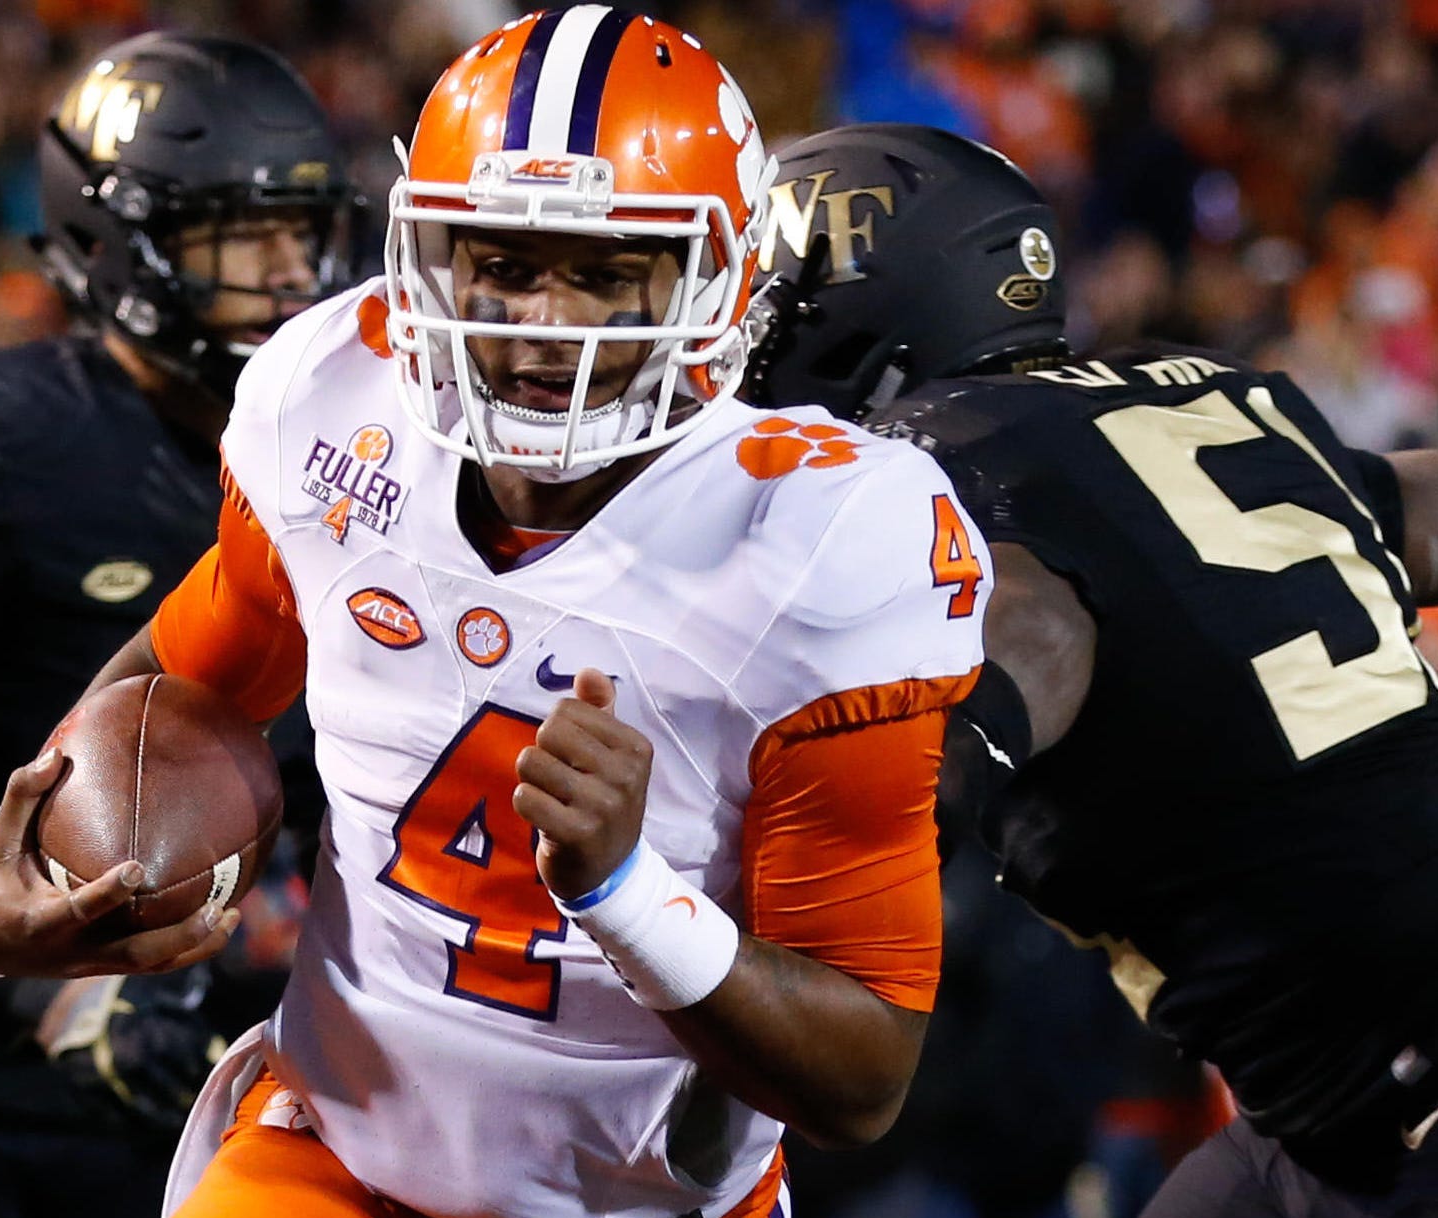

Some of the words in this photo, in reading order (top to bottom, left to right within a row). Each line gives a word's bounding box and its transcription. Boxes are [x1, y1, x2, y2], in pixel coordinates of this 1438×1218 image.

[513, 159, 576, 178] ACC
[757, 169, 894, 285] WF
[304, 438, 401, 518] FULLER
[308, 479, 332, 501] 1975
[321, 495, 353, 546] 4
[357, 506, 380, 528] 1978
[929, 494, 983, 620] 4
[355, 599, 415, 632] ACC
[378, 700, 569, 1022] 4
